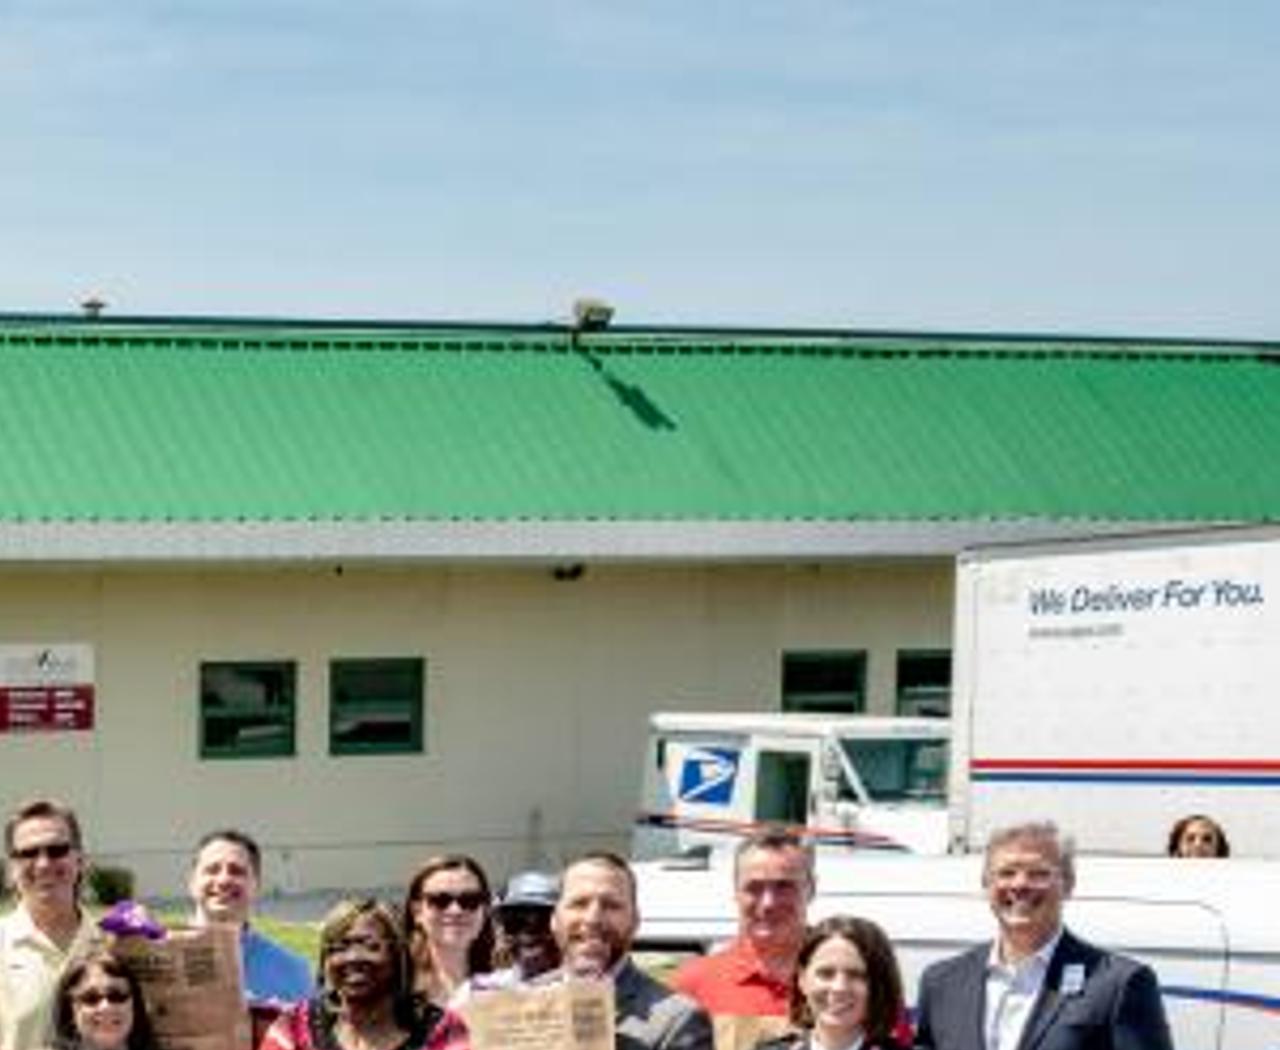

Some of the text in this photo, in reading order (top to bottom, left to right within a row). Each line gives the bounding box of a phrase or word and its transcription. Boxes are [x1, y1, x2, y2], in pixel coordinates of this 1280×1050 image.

[1028, 587, 1066, 616] We
[1070, 584, 1159, 613] Deliver
[1161, 579, 1205, 608] For
